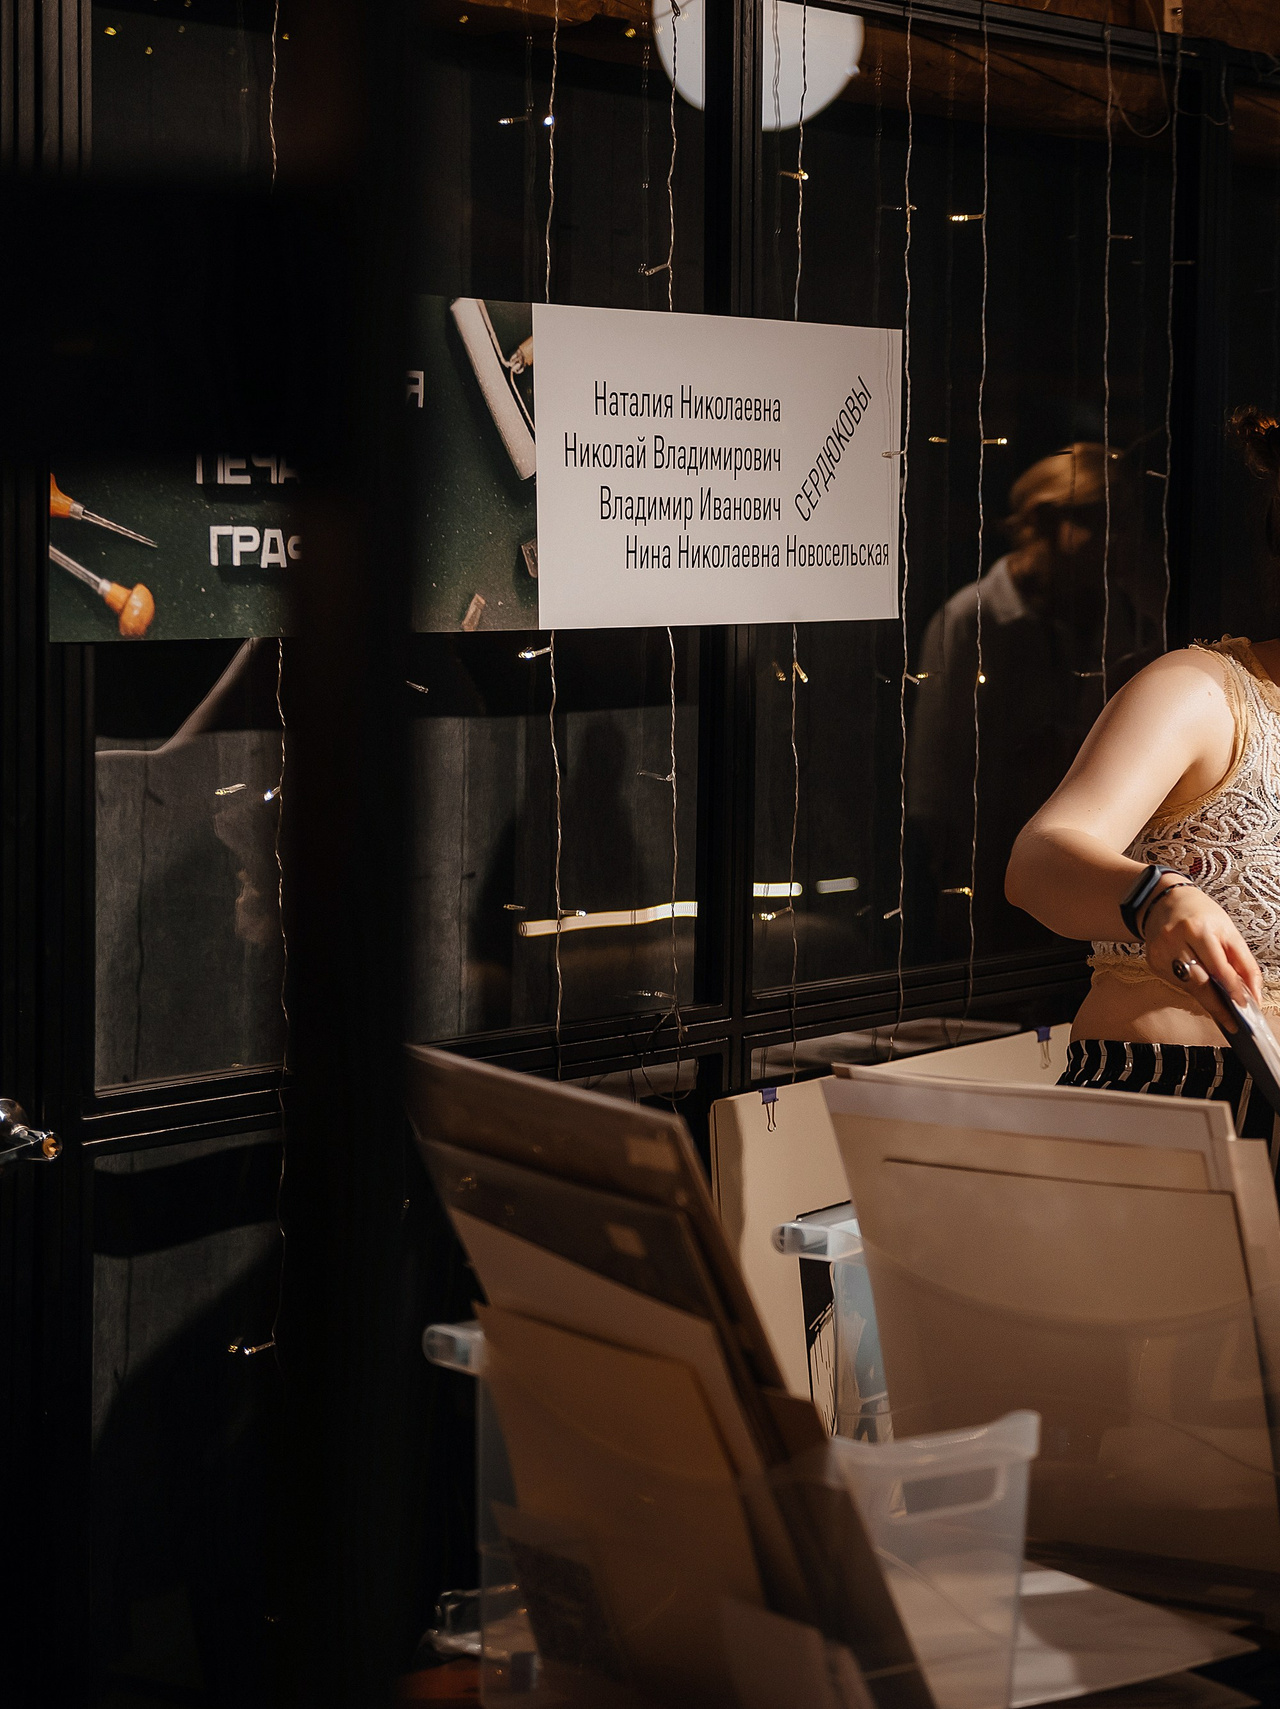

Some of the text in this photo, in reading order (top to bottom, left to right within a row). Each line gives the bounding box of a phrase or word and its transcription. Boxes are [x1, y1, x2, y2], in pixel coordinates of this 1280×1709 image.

[595, 381, 780, 422] Наталия Николаевна
[565, 432, 780, 480] Николай Владимирович
[794, 375, 872, 522] СЕРДЮКОВЫ
[601, 486, 780, 530] Владимир Иванович
[626, 535, 888, 569] Нина Николаевна Новосельская
